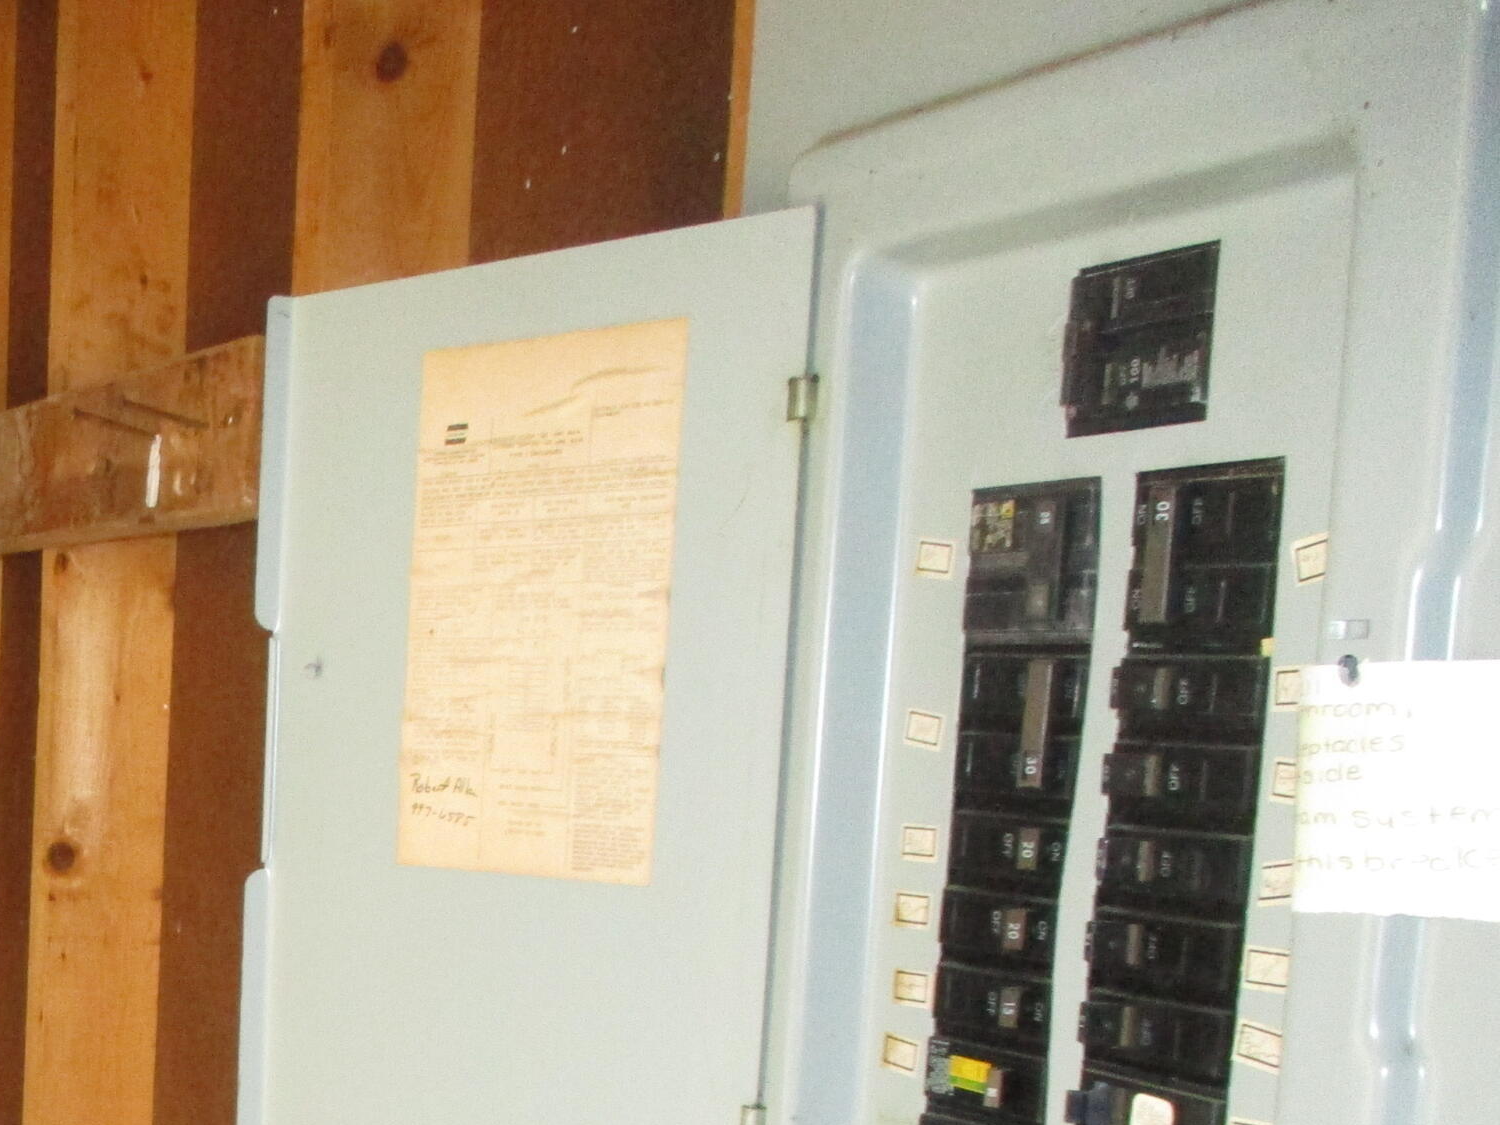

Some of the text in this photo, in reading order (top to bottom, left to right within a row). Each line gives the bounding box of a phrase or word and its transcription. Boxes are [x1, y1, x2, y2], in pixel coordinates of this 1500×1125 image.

[1130, 357, 1141, 383] 100
[1155, 500, 1170, 521] 30
[1024, 756, 1036, 775] 30
[1021, 842, 1035, 858] 20
[1008, 923, 1020, 939] 20
[1003, 1002, 1016, 1016] 15
